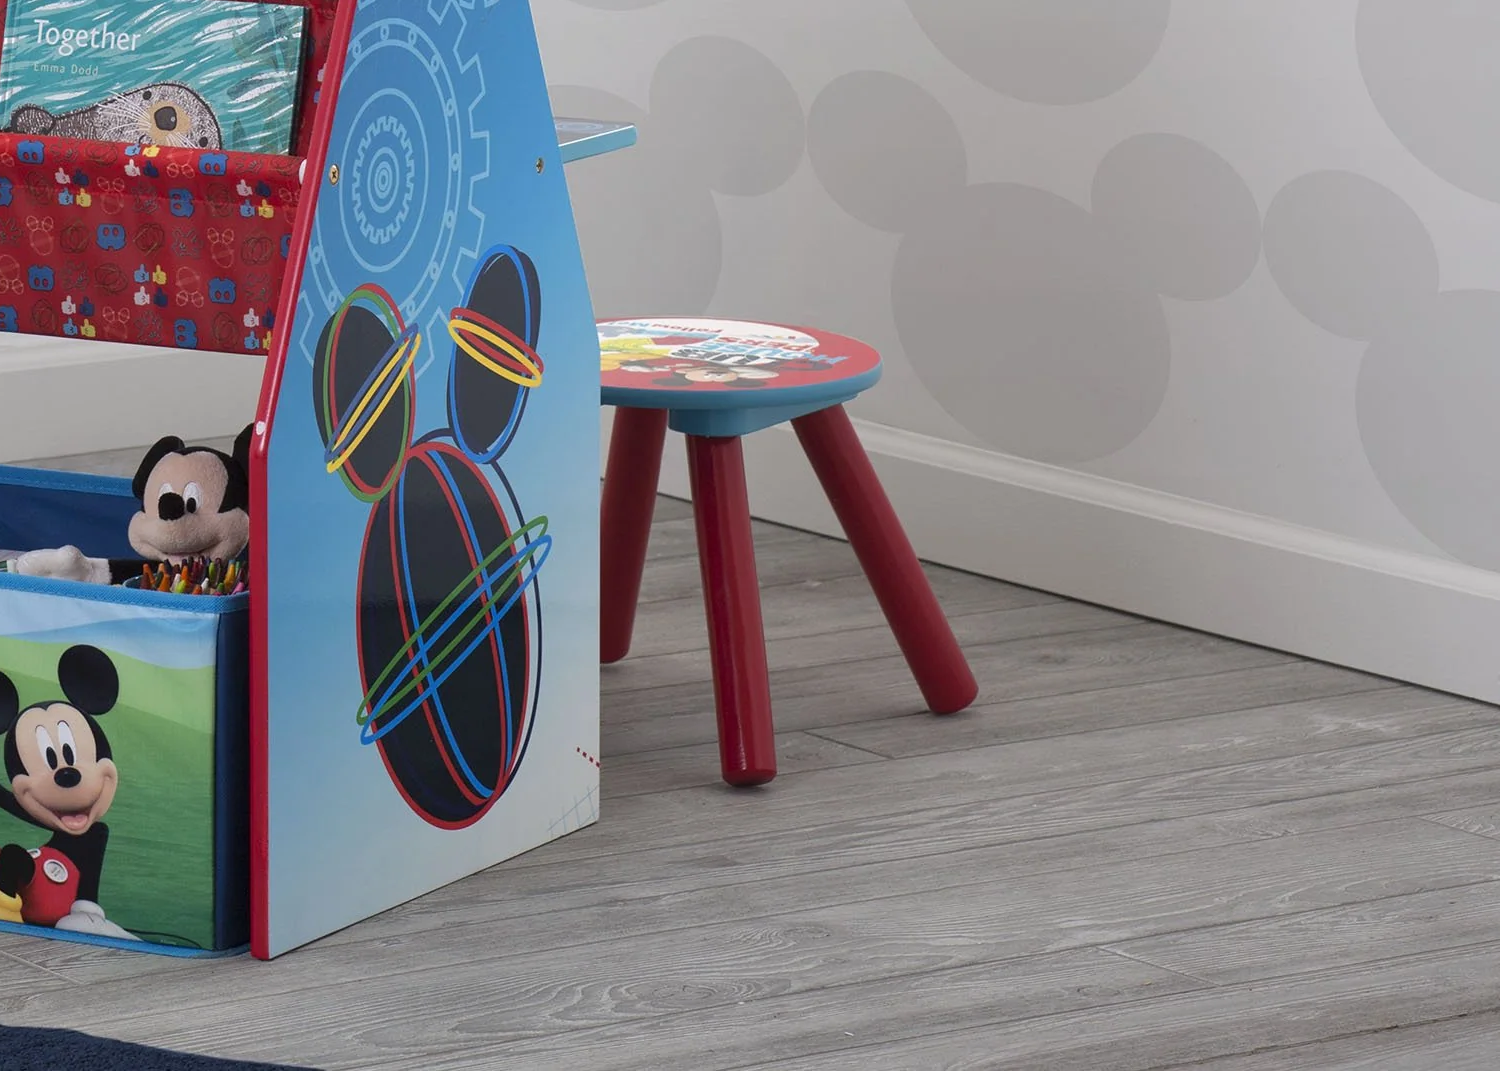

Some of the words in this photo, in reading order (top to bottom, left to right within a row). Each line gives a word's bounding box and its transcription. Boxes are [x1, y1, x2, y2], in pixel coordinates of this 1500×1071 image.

[34, 19, 142, 56] Together
[33, 61, 66, 74] Emma
[71, 63, 99, 77] Dodd
